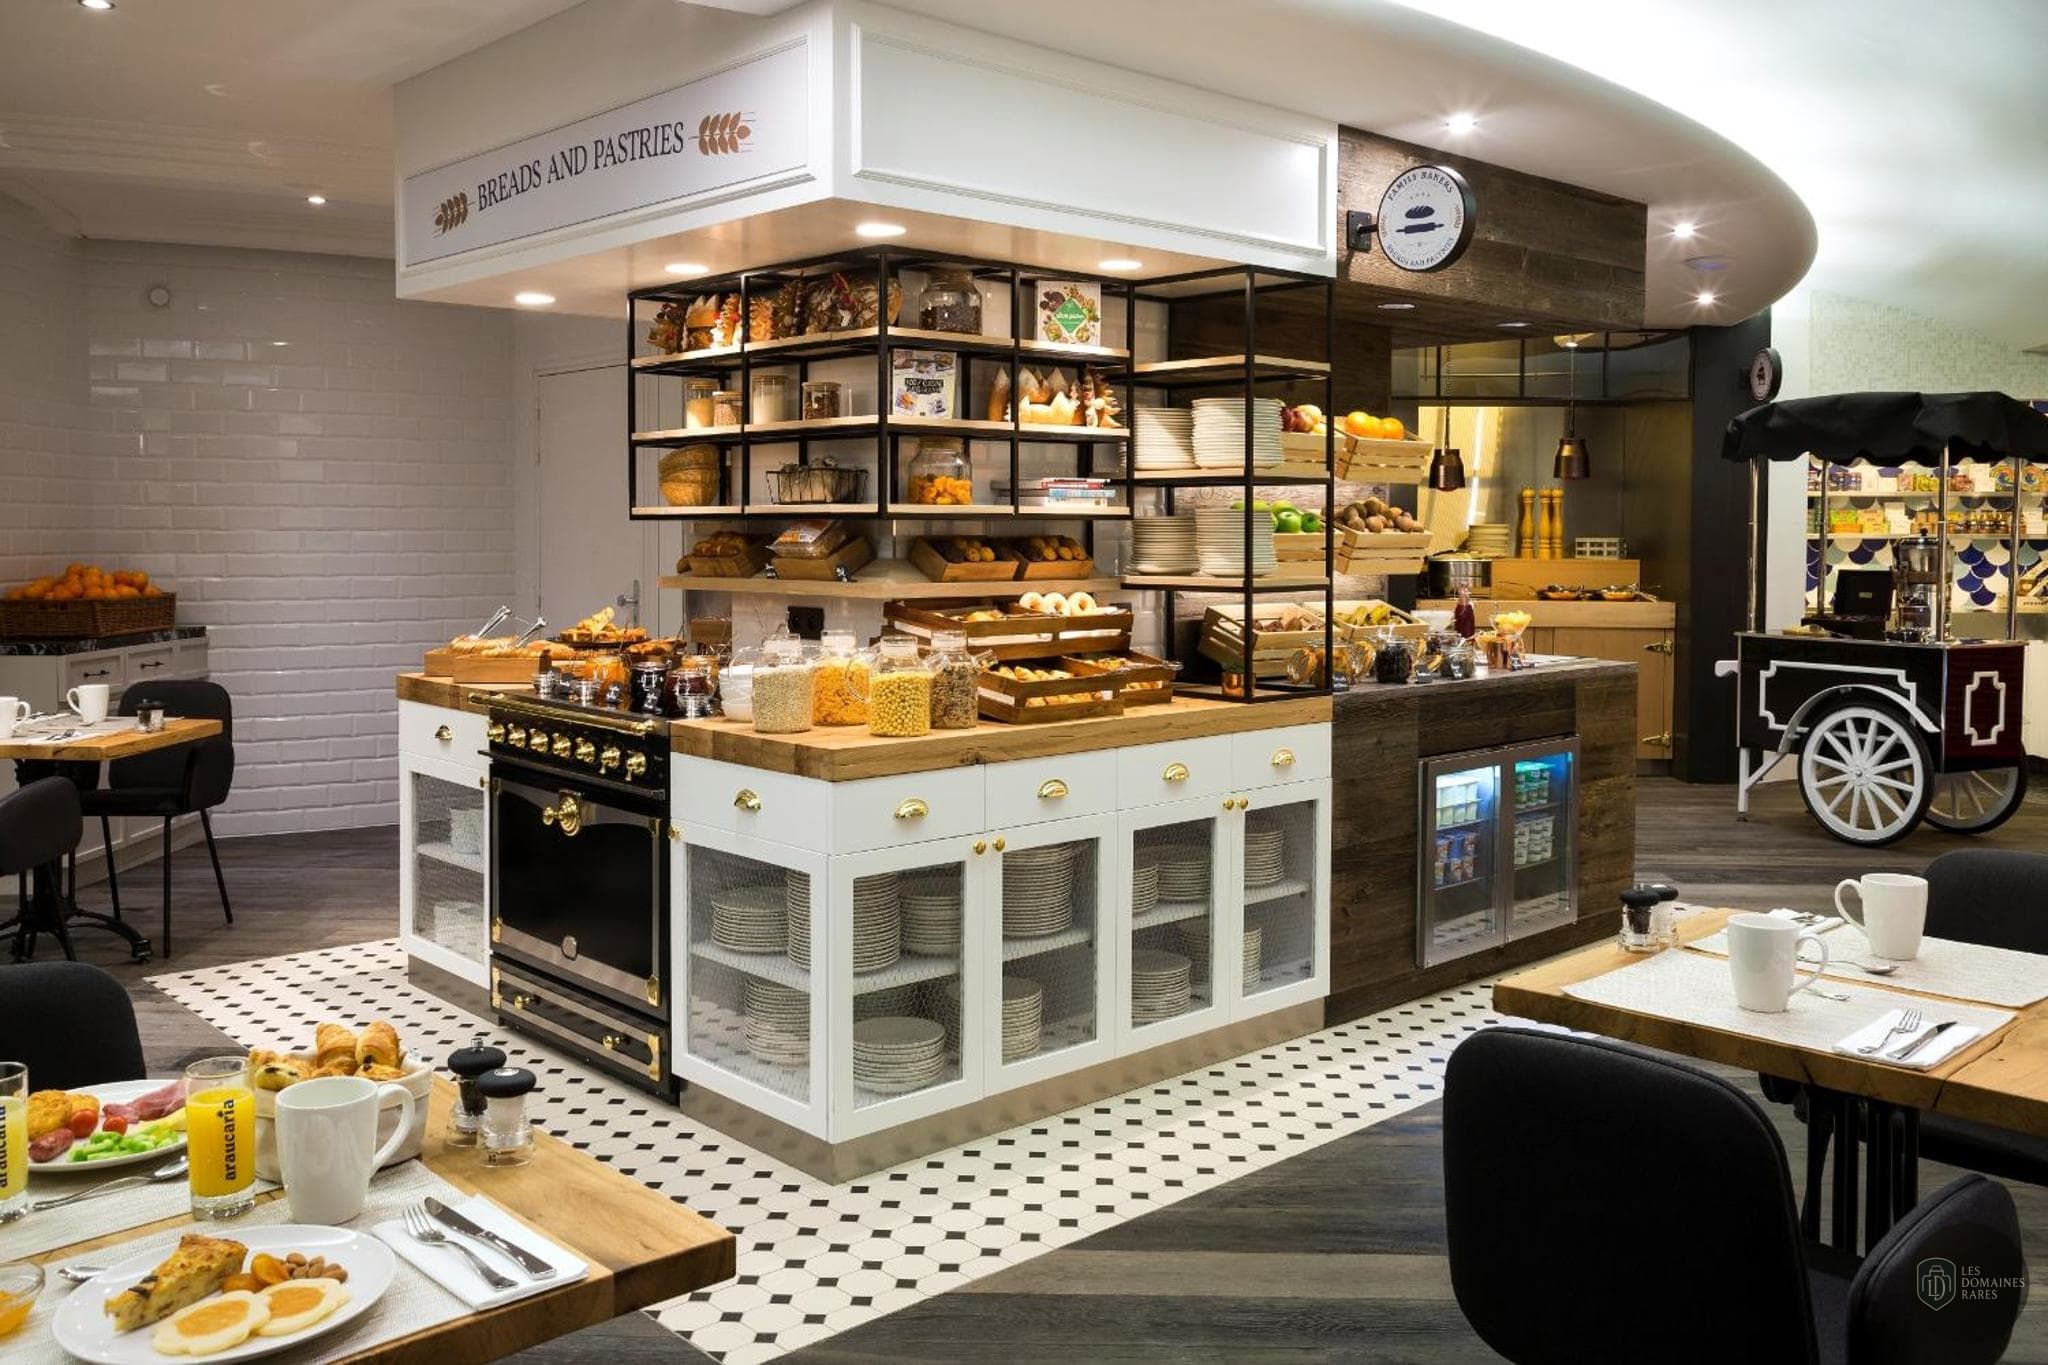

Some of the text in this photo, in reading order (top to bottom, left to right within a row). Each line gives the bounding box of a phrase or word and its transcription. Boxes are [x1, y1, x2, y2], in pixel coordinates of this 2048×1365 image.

[477, 121, 685, 212] BREADS AND PASTRIES
[1387, 173, 1417, 201] FAMILY
[217, 1098, 237, 1181] araucaria
